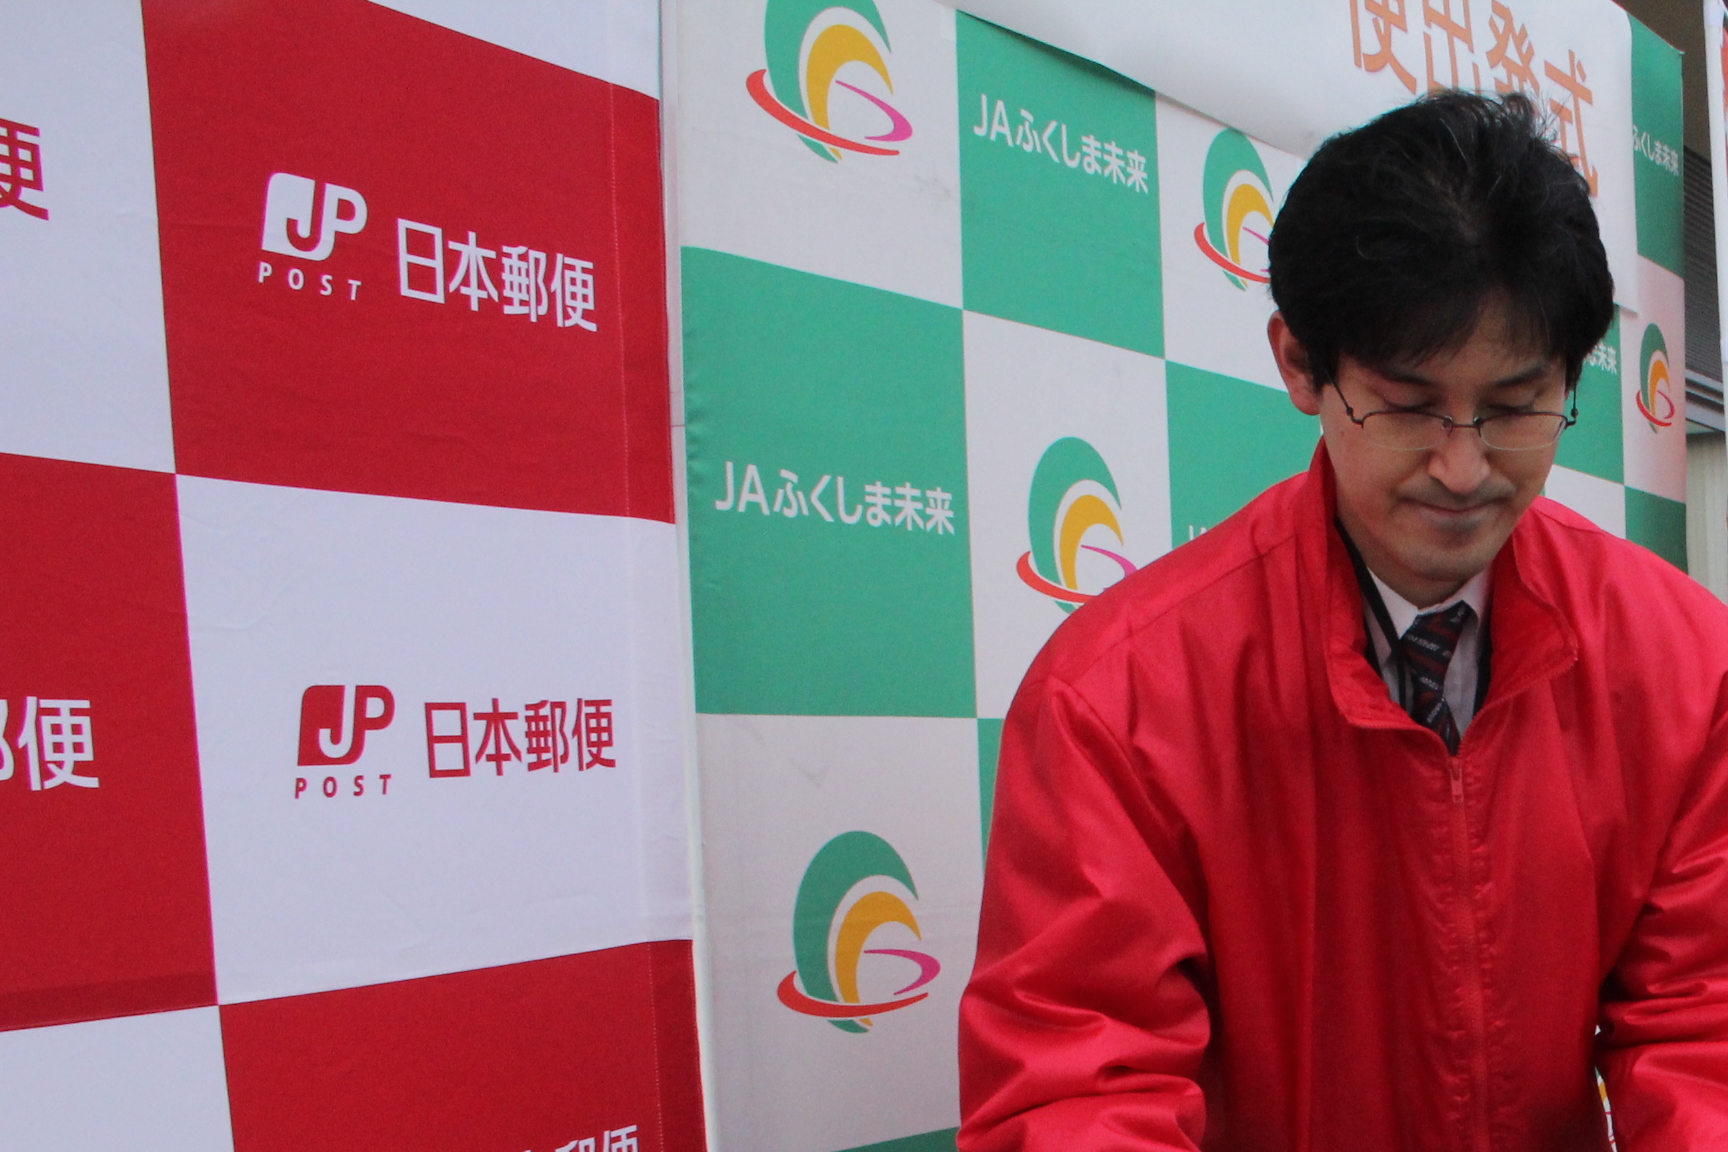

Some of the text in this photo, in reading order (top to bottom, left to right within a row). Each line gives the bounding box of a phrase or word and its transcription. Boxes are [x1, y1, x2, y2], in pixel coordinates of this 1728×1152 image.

[973, 94, 1149, 194] JAふくしま未来
[258, 261, 362, 301] POST
[397, 217, 598, 332] 日本郵便
[715, 461, 955, 535] JAふくしま未来
[0, 696, 100, 793] 便
[423, 697, 617, 780] 日本郵便
[294, 773, 392, 799] POST
